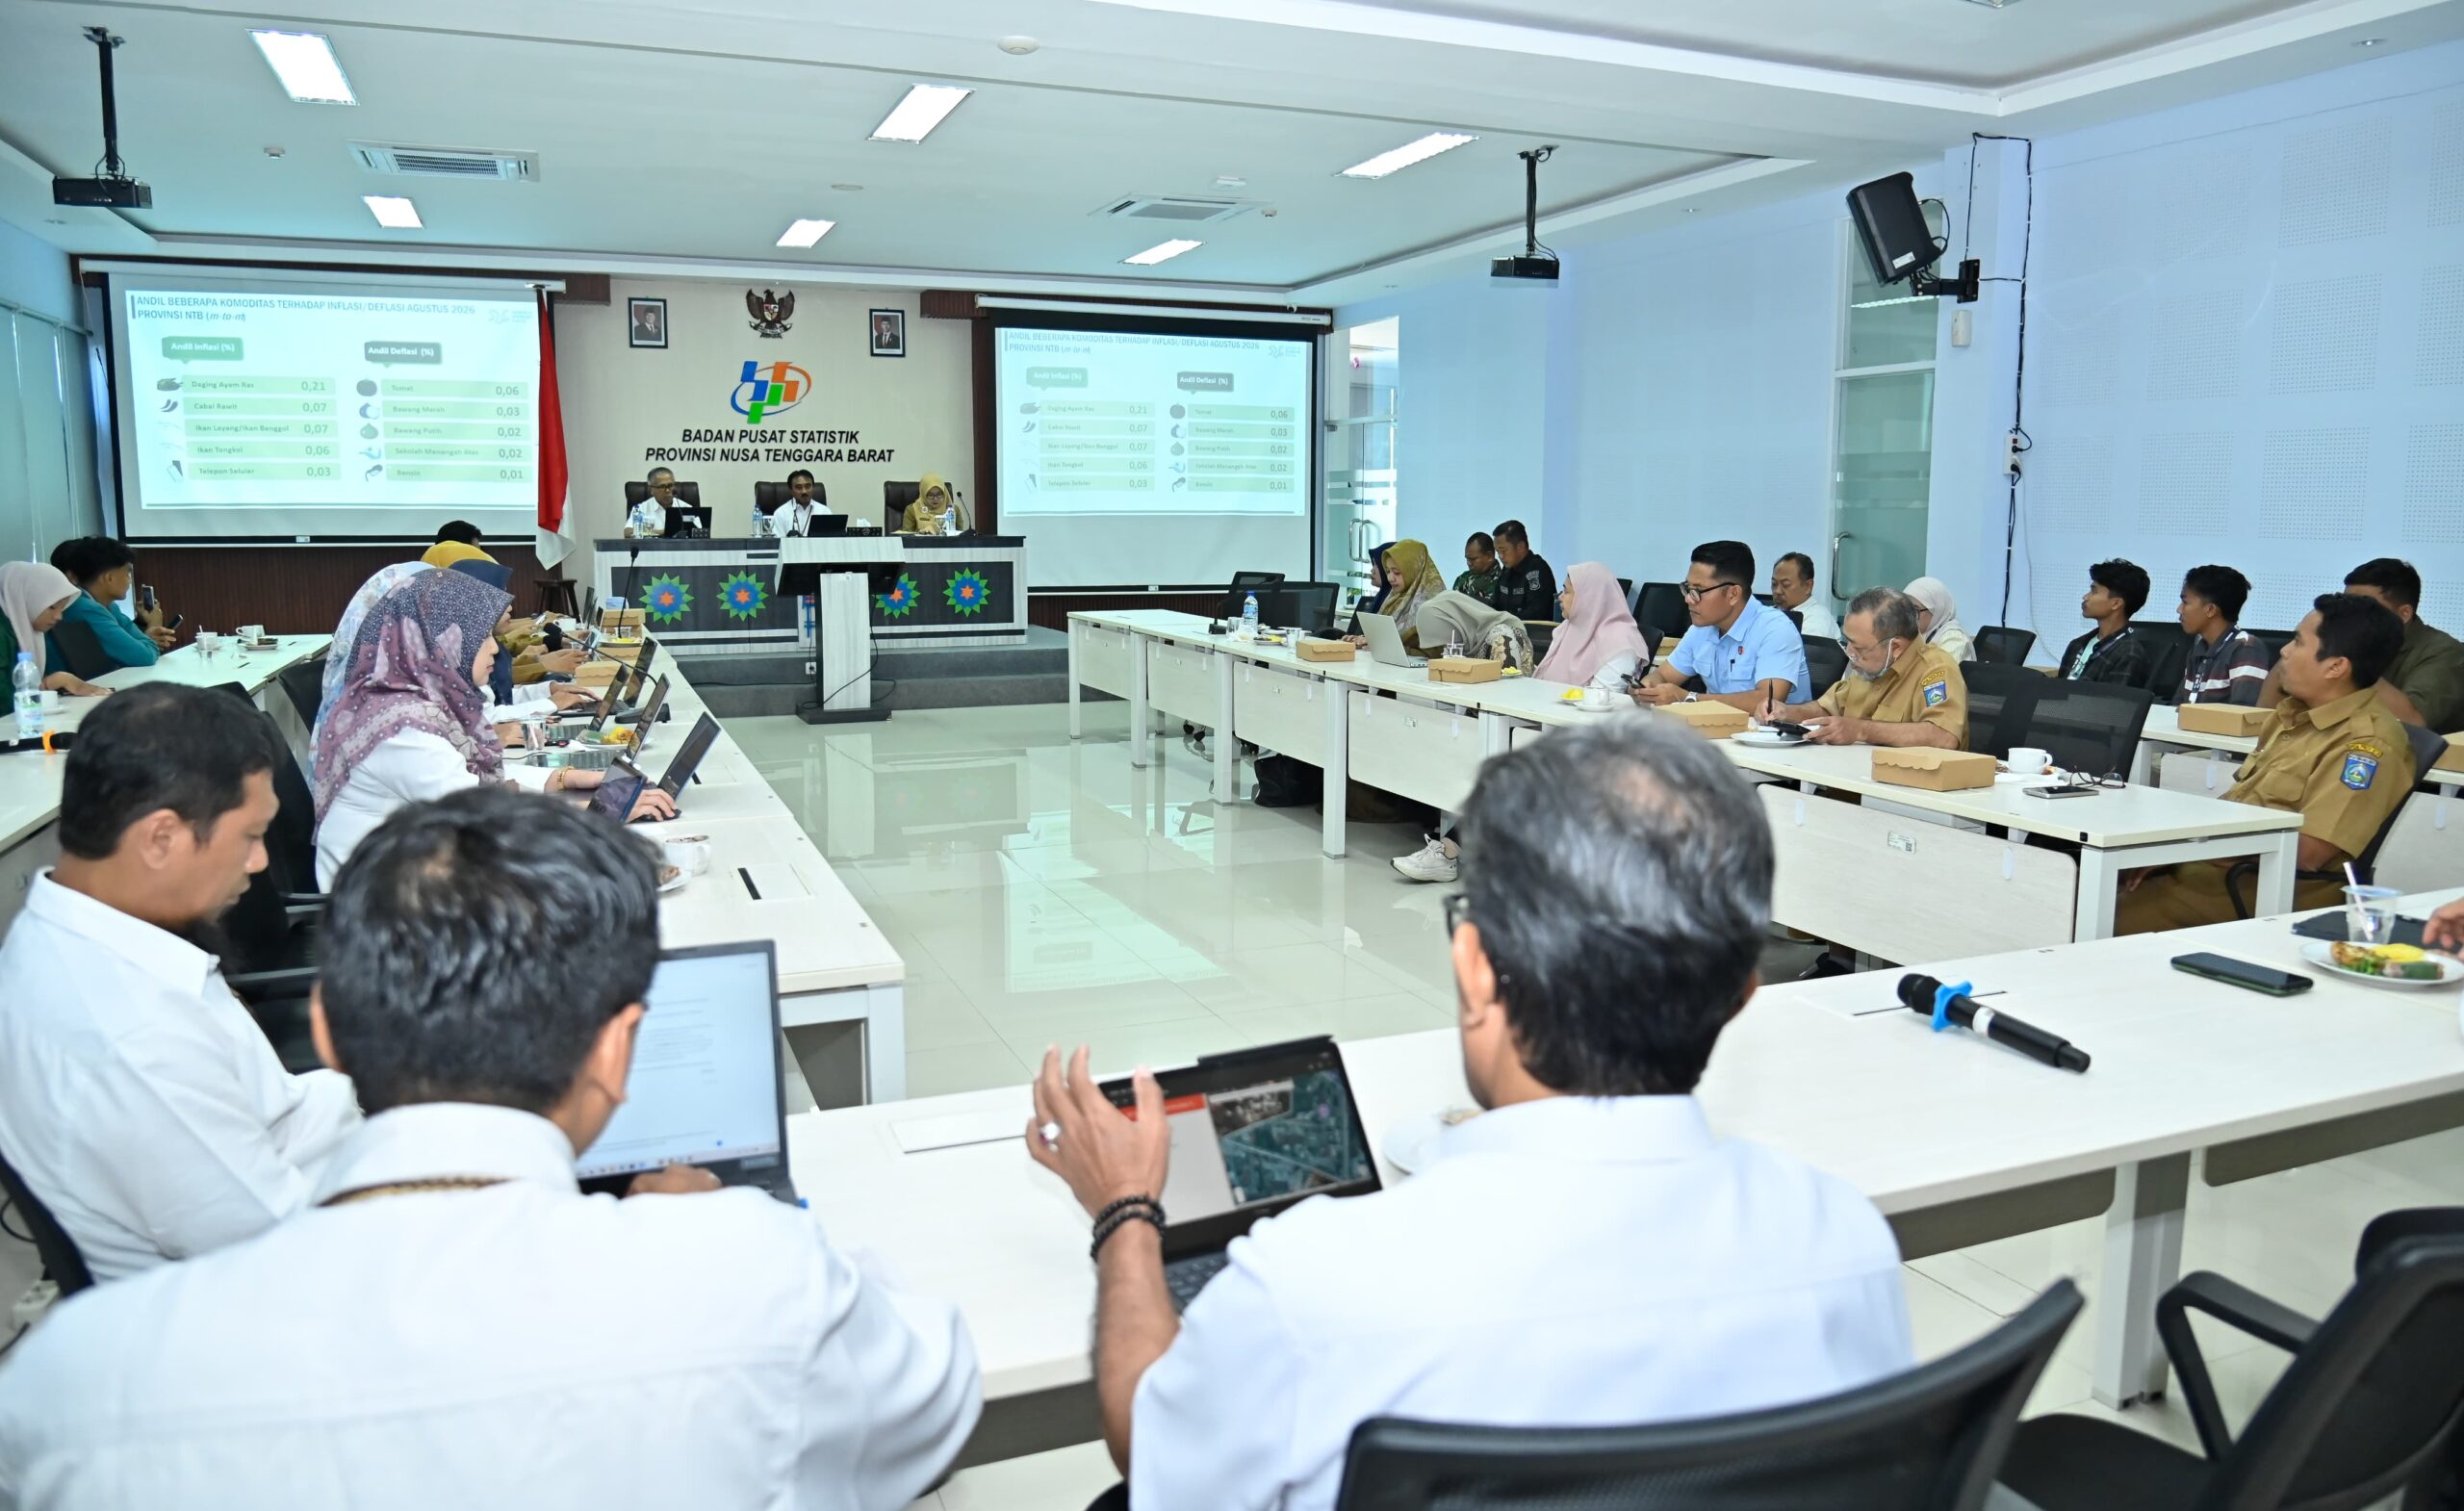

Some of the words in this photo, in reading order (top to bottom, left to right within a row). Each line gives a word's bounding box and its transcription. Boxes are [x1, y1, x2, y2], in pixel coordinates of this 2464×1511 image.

[137, 296, 165, 307] ANDIL
[167, 296, 218, 308] BEBERAPA
[220, 298, 274, 309] KOMODITAS
[277, 299, 326, 310] TERHADAP
[368, 302, 404, 312] DEFLASI
[407, 303, 448, 313] AGUSTUS
[451, 305, 475, 314] 2026
[138, 309, 183, 320] PROVINSI
[185, 310, 204, 320] NTB
[1009, 332, 1031, 341] ANDIL
[1071, 334, 1114, 344] KOMODITAS
[1115, 335, 1151, 345] TERHADAP
[1181, 339, 1208, 347] DEFLASI
[1210, 340, 1240, 348] AGUSTUS
[171, 342, 193, 352] Andil
[194, 342, 220, 352] Inflasi
[221, 342, 235, 354] (%)
[368, 346, 389, 356] Andil
[390, 347, 417, 356] Deflasi
[421, 347, 434, 357] (%)
[1009, 343, 1044, 352] PROVINSI
[1045, 344, 1059, 352] NTB
[301, 381, 326, 392] 0,21
[1180, 376, 1195, 384] Andil
[1196, 376, 1217, 385] Deflasi
[1219, 377, 1229, 386] (%)
[496, 386, 520, 397] 0,06
[303, 402, 327, 413] 0,07
[497, 406, 521, 417] 0,03
[1129, 405, 1148, 415] 0,21
[1270, 410, 1288, 420] 0,06
[304, 424, 328, 435] 0,07
[498, 427, 522, 438] 0,02
[1129, 423, 1148, 433] 0,07
[1270, 427, 1288, 437] 0,03
[682, 429, 735, 443] BADAN
[739, 430, 786, 444] PUSAT
[789, 430, 860, 444] STATISTIK
[305, 446, 330, 456] 0,06
[1129, 442, 1148, 452] 0,07
[1270, 445, 1288, 455] 0,02
[499, 448, 523, 459] 0,02
[645, 448, 716, 462] PROVINSI
[719, 448, 760, 462] NUSA
[765, 448, 844, 462] TENGGARA
[847, 449, 895, 462] BARAT
[307, 466, 331, 477] 0,03
[1129, 461, 1148, 471] 0,06
[1270, 463, 1288, 473] 0,02
[500, 470, 524, 480] 0,01
[1129, 479, 1148, 489] 0,03
[1270, 481, 1287, 491] 0,01
